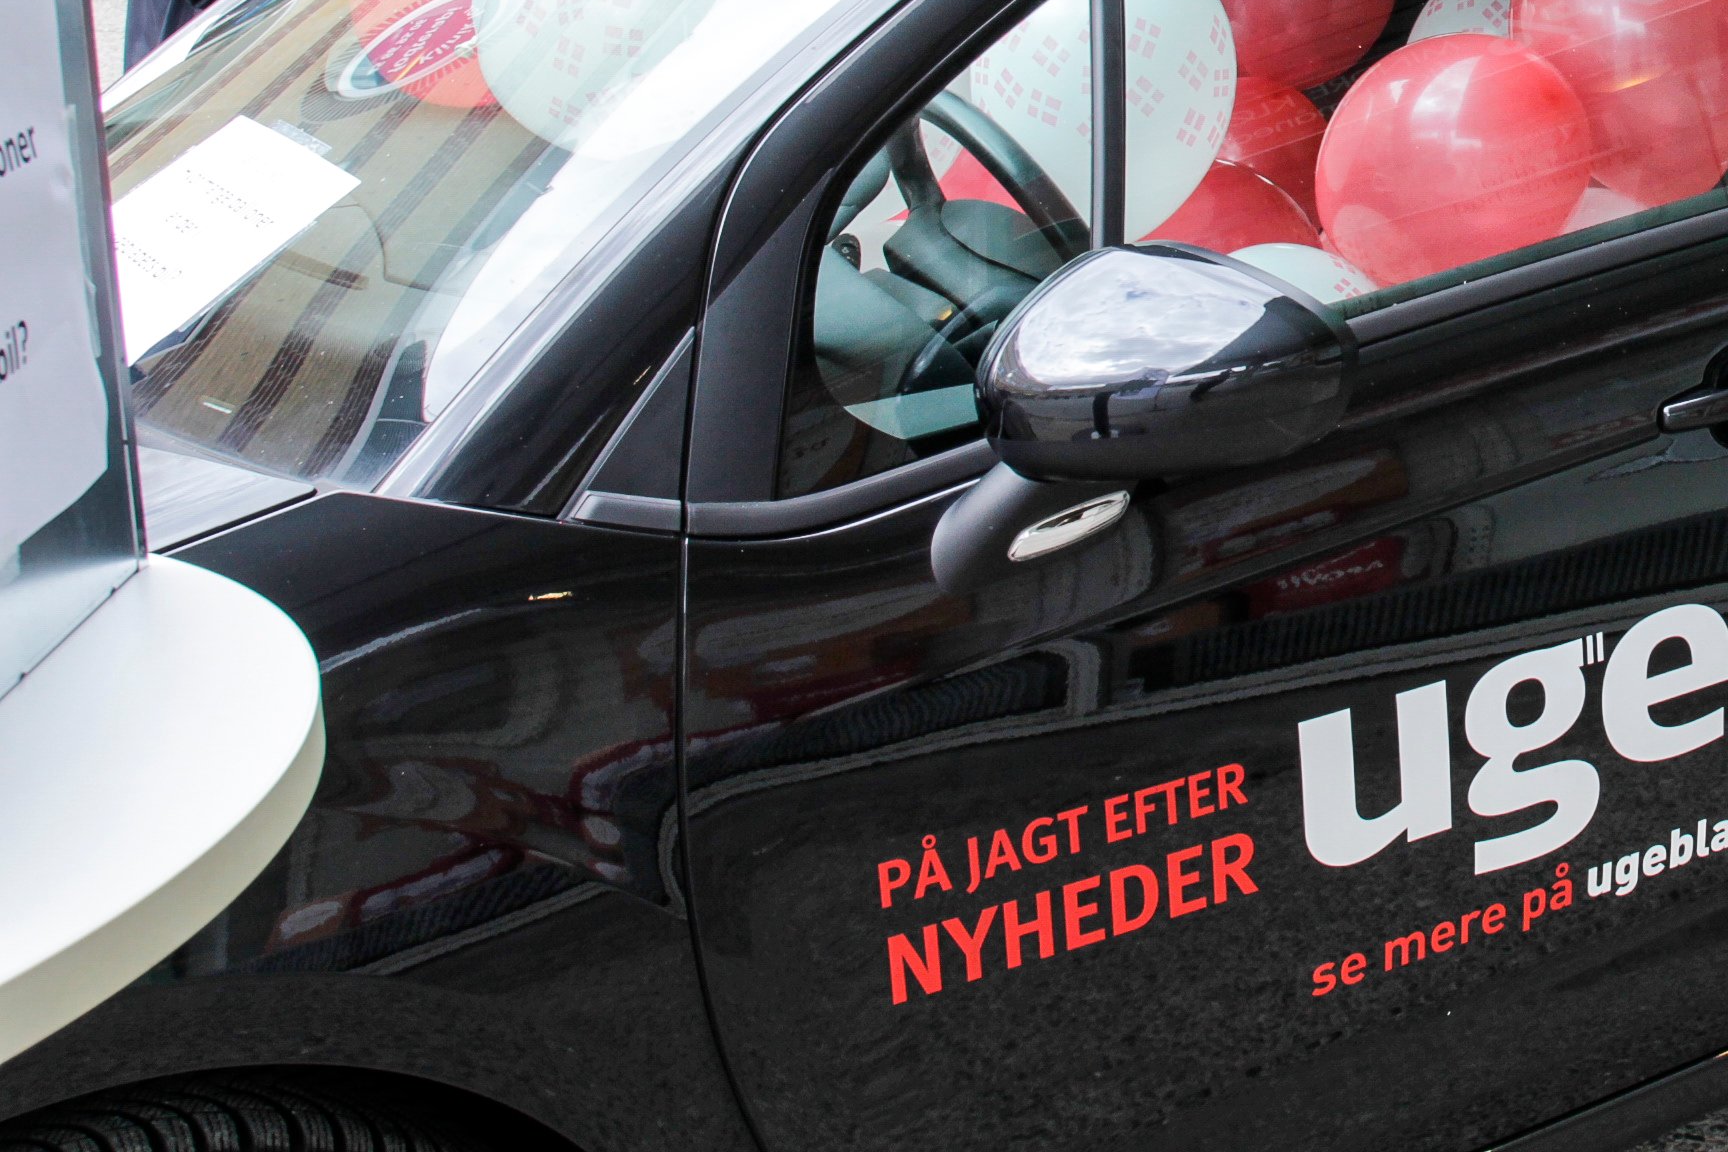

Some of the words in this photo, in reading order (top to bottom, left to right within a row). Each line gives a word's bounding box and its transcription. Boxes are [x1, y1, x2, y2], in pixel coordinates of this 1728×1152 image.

[877, 834, 953, 909] PÅ
[965, 805, 1089, 894] JAGT
[1104, 763, 1249, 843] EFTER
[887, 833, 1259, 1005] NYHEDER
[1311, 952, 1367, 997] se
[1384, 903, 1507, 972] mere
[1522, 862, 1573, 932] på
